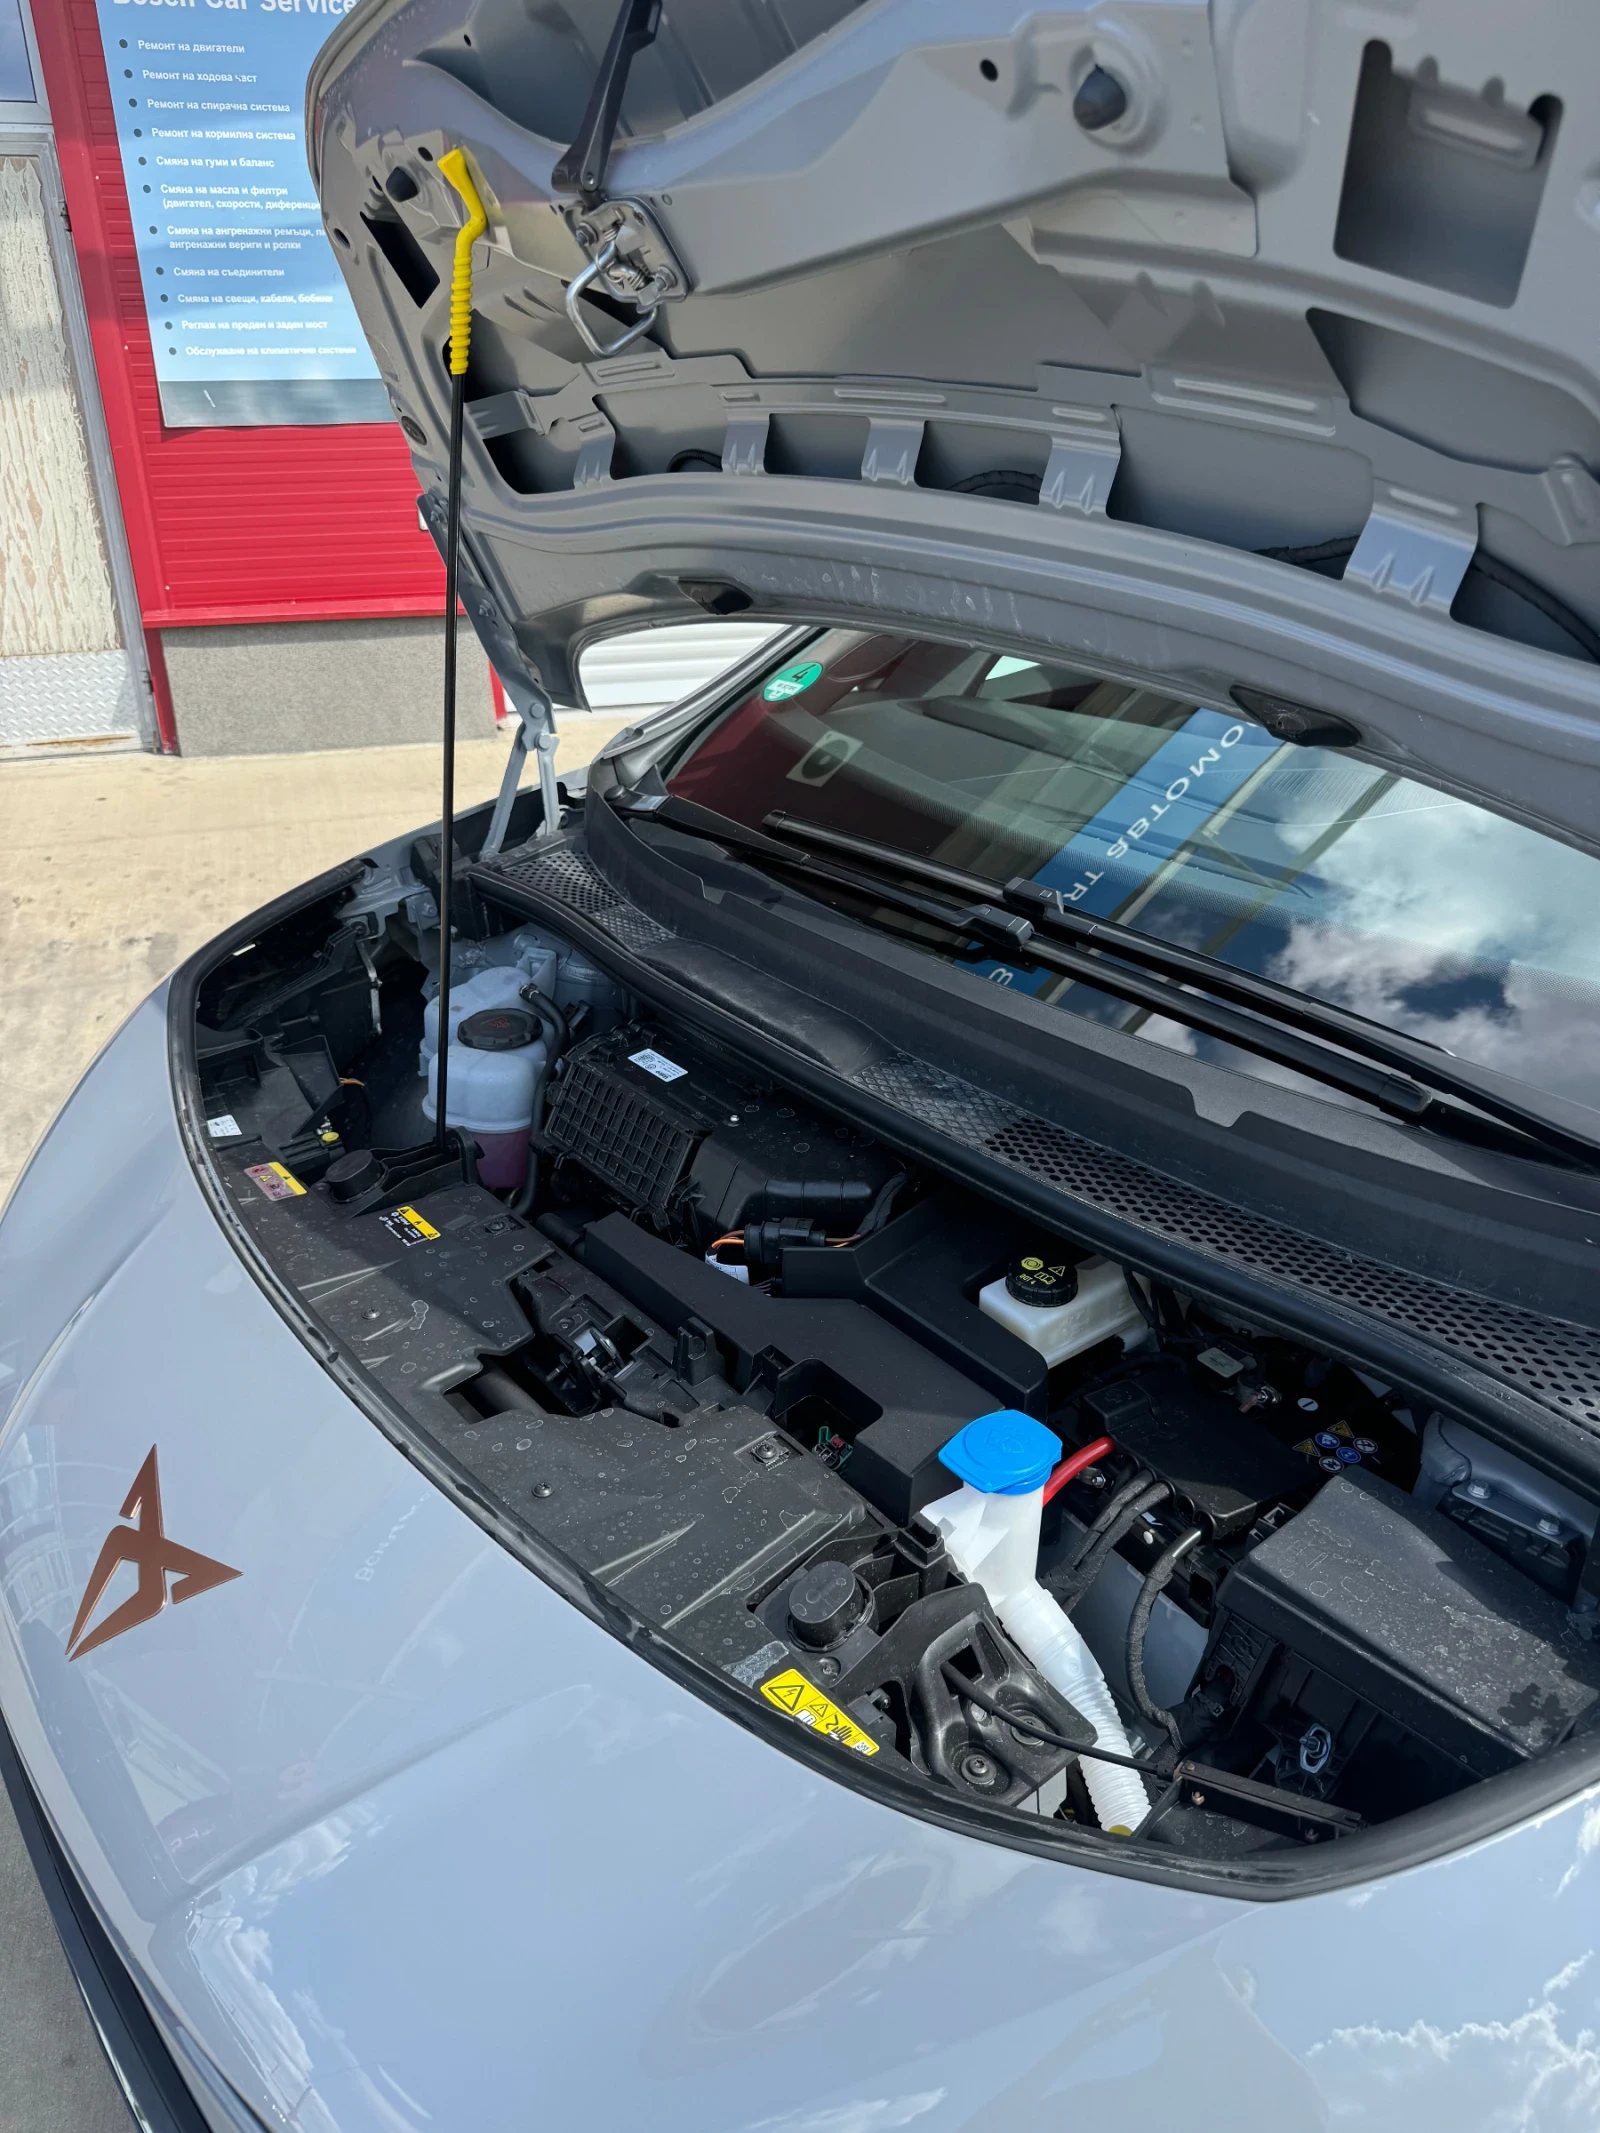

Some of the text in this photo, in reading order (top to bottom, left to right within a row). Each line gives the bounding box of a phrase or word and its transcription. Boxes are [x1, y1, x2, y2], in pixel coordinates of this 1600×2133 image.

[138, 40, 245, 53] Ремонт на двигатели
[142, 69, 180, 79] Ремонт
[182, 72, 195, 80] на
[197, 73, 233, 82] ходова
[147, 99, 290, 112] Ремонт на спирачна система
[151, 128, 295, 140] Ремонт на кормилна система
[156, 156, 189, 166] Смяна
[191, 158, 203, 166] на
[205, 159, 228, 168] гуми
[239, 157, 274, 167] баланс
[160, 184, 193, 193] Смяна
[195, 186, 207, 194] на
[250, 186, 288, 196] филтри
[265, 200, 320, 210] диференци
[167, 225, 199, 235] Смяна
[201, 227, 213, 235] на
[215, 227, 272, 237] ангренажни
[169, 241, 227, 250] ангренажни
[229, 241, 262, 250] вериги
[273, 241, 301, 251] ролки
[173, 267, 285, 278] Смяна на съединители
[177, 294, 209, 303] Смяна
[211, 295, 223, 303] на
[218, 321, 229, 329] на
